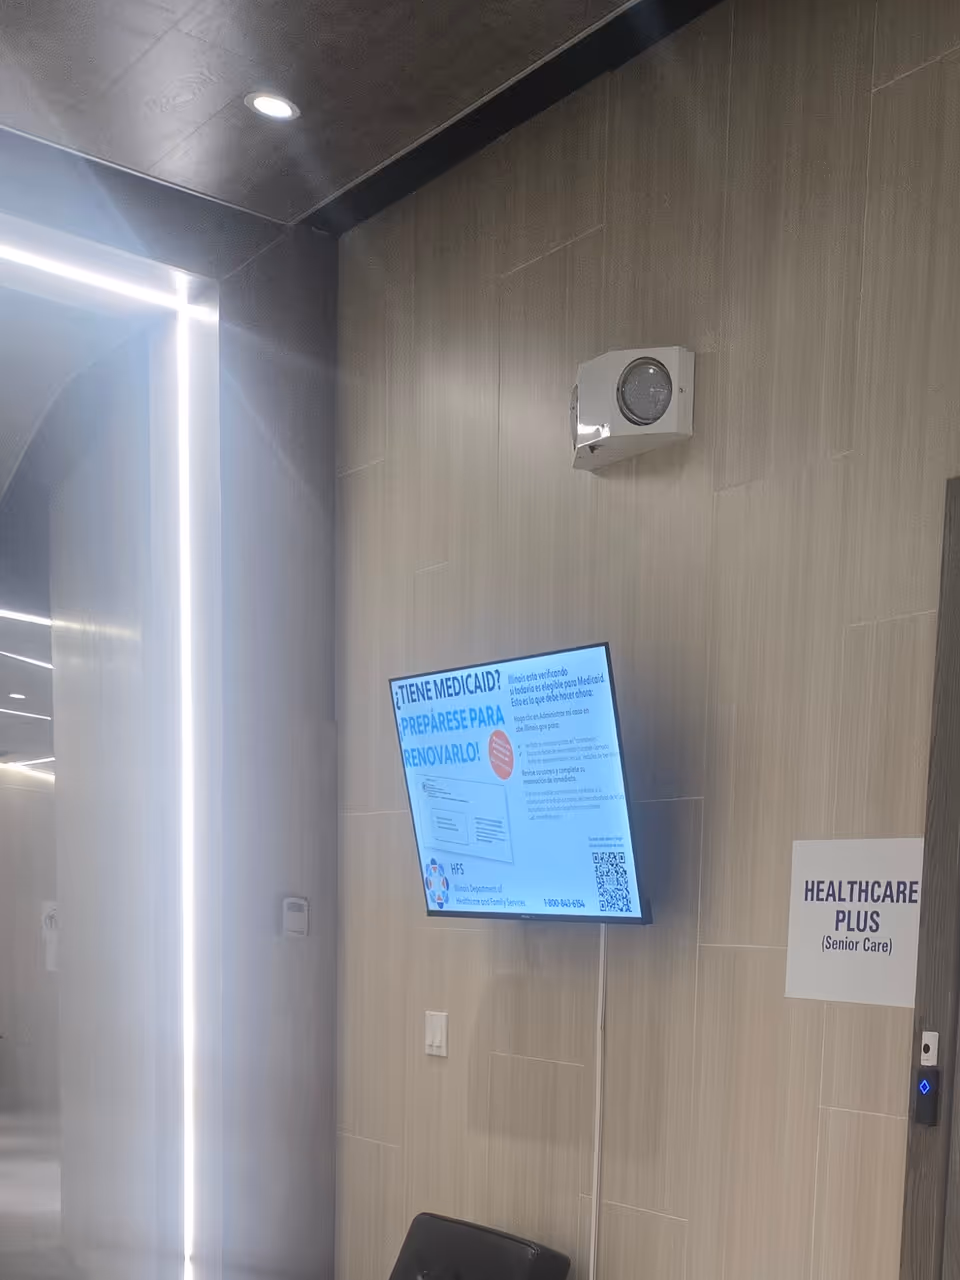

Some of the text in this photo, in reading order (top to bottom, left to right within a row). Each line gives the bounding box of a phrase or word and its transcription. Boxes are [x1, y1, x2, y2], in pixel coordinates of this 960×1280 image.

[395, 669, 501, 710] ¿TIENE MEDICAID?
[469, 705, 505, 728] PARA
[404, 742, 480, 768] RENOVARLO!
[450, 864, 465, 876] HFS
[804, 880, 918, 903] HEALTHCARE
[835, 910, 880, 932] PLUS
[822, 935, 892, 956] (Senior Care)
